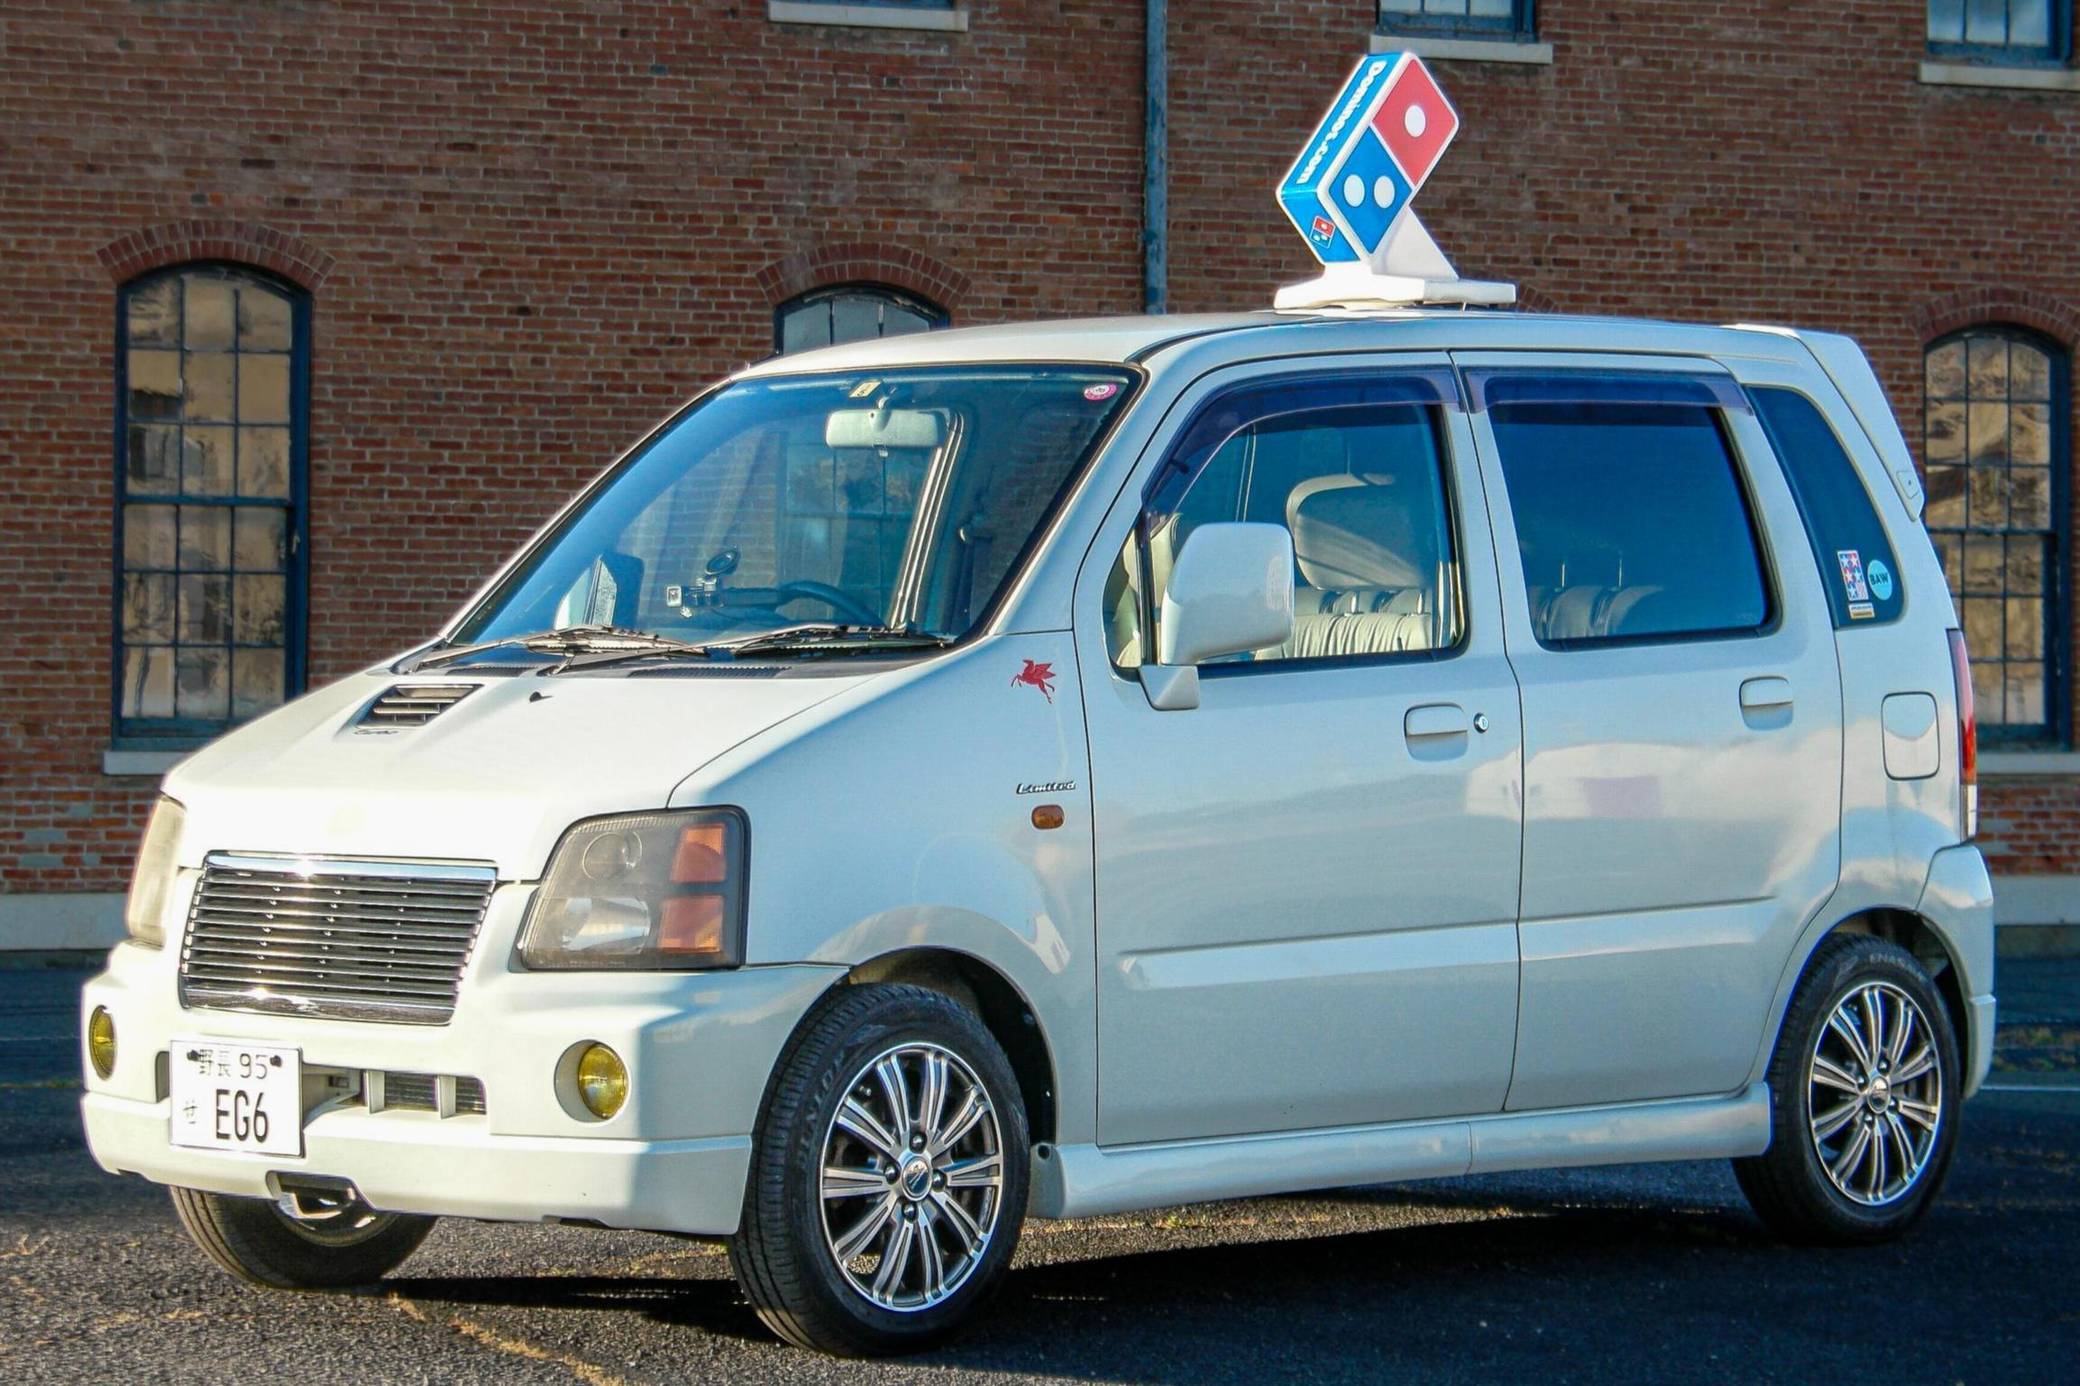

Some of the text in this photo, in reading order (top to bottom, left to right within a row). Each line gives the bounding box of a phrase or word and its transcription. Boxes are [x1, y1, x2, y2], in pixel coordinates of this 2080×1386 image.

[1869, 573, 1889, 586] BAW
[1016, 781, 1076, 795] Limited
[239, 1052, 268, 1080] 95
[215, 1088, 269, 1143] EG6
